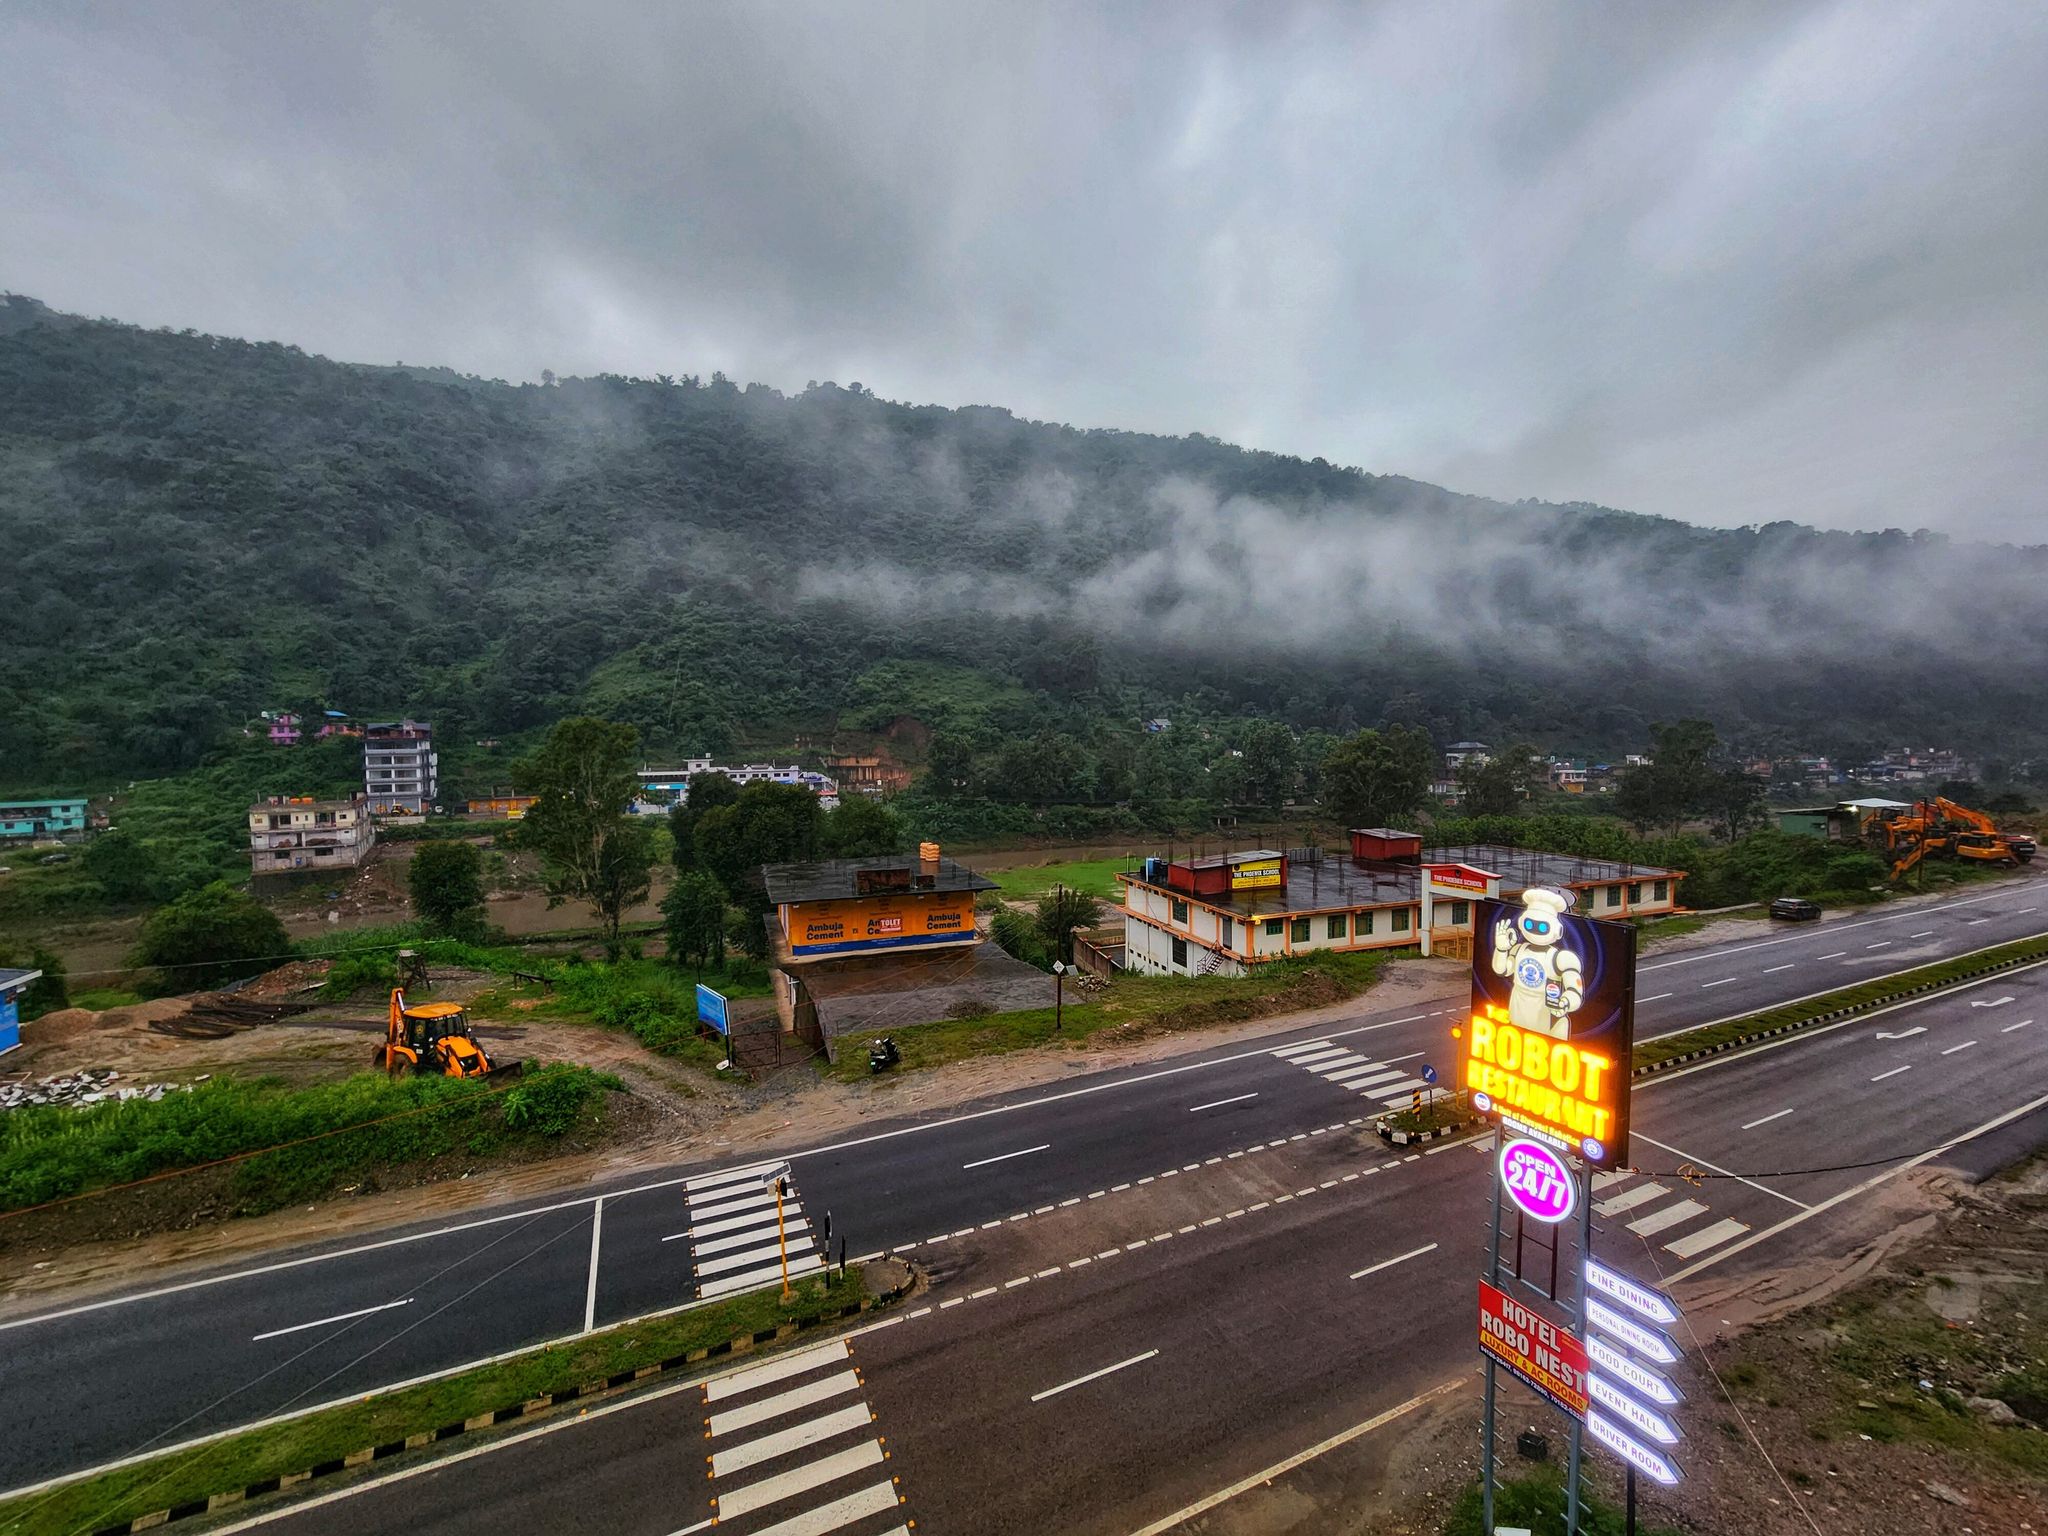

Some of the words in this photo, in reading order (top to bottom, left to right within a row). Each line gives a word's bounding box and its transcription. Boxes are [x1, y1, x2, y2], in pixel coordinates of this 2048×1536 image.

[806, 922, 843, 932] Ambuja
[806, 931, 844, 941] Cement
[926, 920, 962, 930] Cement
[927, 912, 961, 922] Ambuja
[1486, 1004, 1511, 1024] THE
[1471, 1015, 1609, 1102] ROBOT
[1467, 1059, 1610, 1141] RESTAURANT
[1502, 1116, 1529, 1134] ROOMS
[1528, 1127, 1569, 1152] AVAILABLE
[1508, 1160, 1567, 1209] 24/7
[1514, 1150, 1557, 1179] OPEN
[1592, 1270, 1616, 1292] FINE
[1619, 1285, 1658, 1315] DINING
[1502, 1298, 1561, 1353] HOTEL
[1592, 1308, 1620, 1330] PERSONAL
[1620, 1325, 1641, 1343] DINING
[1641, 1337, 1660, 1353] ROOM
[1481, 1308, 1529, 1356] ROBO
[1536, 1344, 1587, 1393] NEST
[1484, 1333, 1519, 1363] LUXURY
[1521, 1359, 1529, 1371] &
[1531, 1366, 1544, 1381] AC
[1546, 1377, 1584, 1408] ROOMS
[1592, 1345, 1620, 1369] FOOD
[1623, 1365, 1660, 1394] COURT
[1595, 1383, 1628, 1411] EVENT
[1631, 1407, 1658, 1434] HALL
[1593, 1420, 1628, 1451] DRIVER
[1631, 1447, 1662, 1475] ROOM
